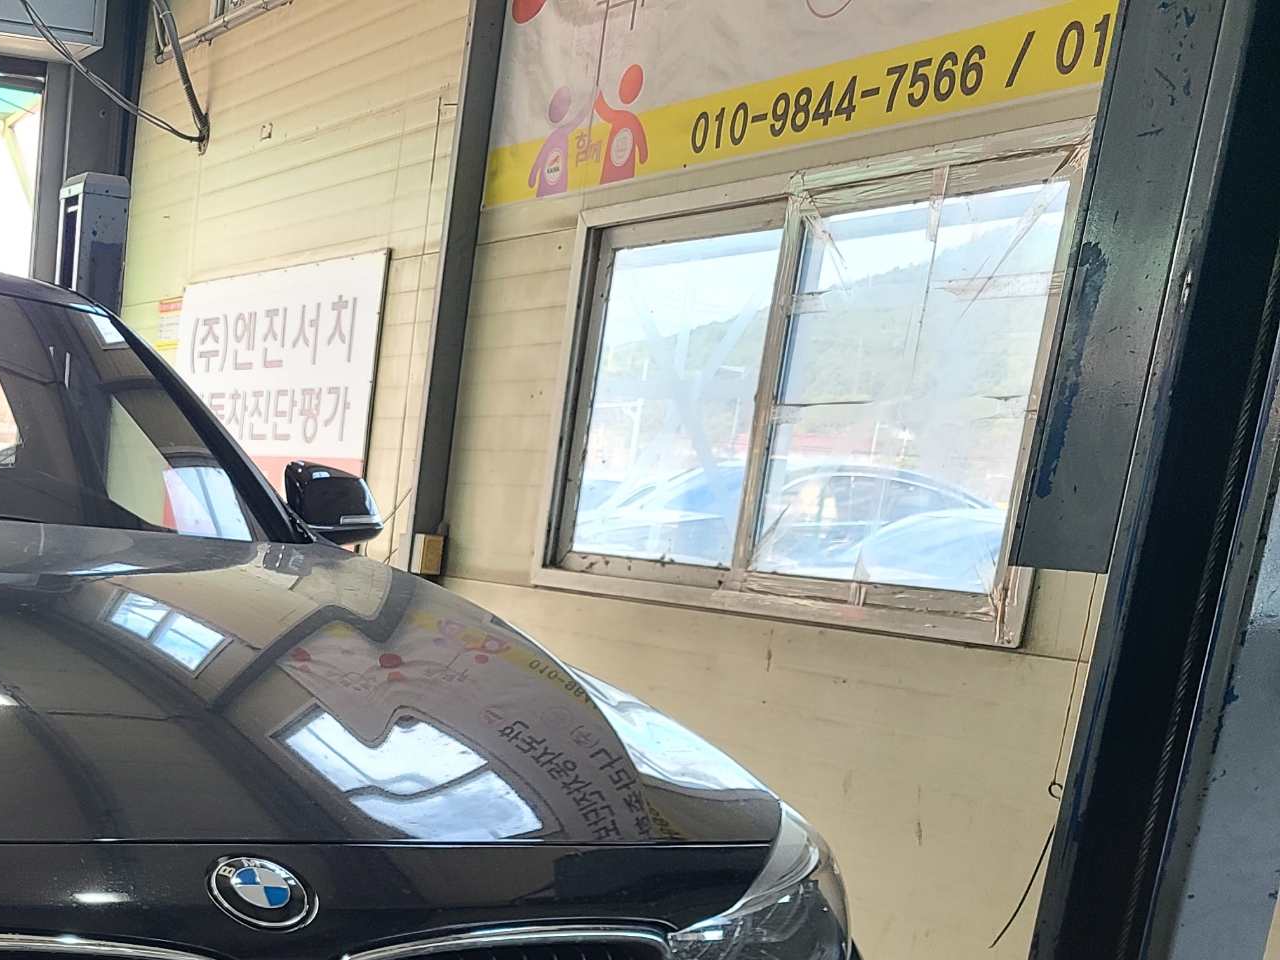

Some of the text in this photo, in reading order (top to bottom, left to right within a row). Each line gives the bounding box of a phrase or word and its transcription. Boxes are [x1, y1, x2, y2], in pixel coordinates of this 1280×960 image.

[691, 44, 986, 154] 010-9844-7566
[190, 294, 358, 374] (주)엔진서치
[201, 386, 351, 443] 동차진단평가
[218, 858, 297, 886] BMW
